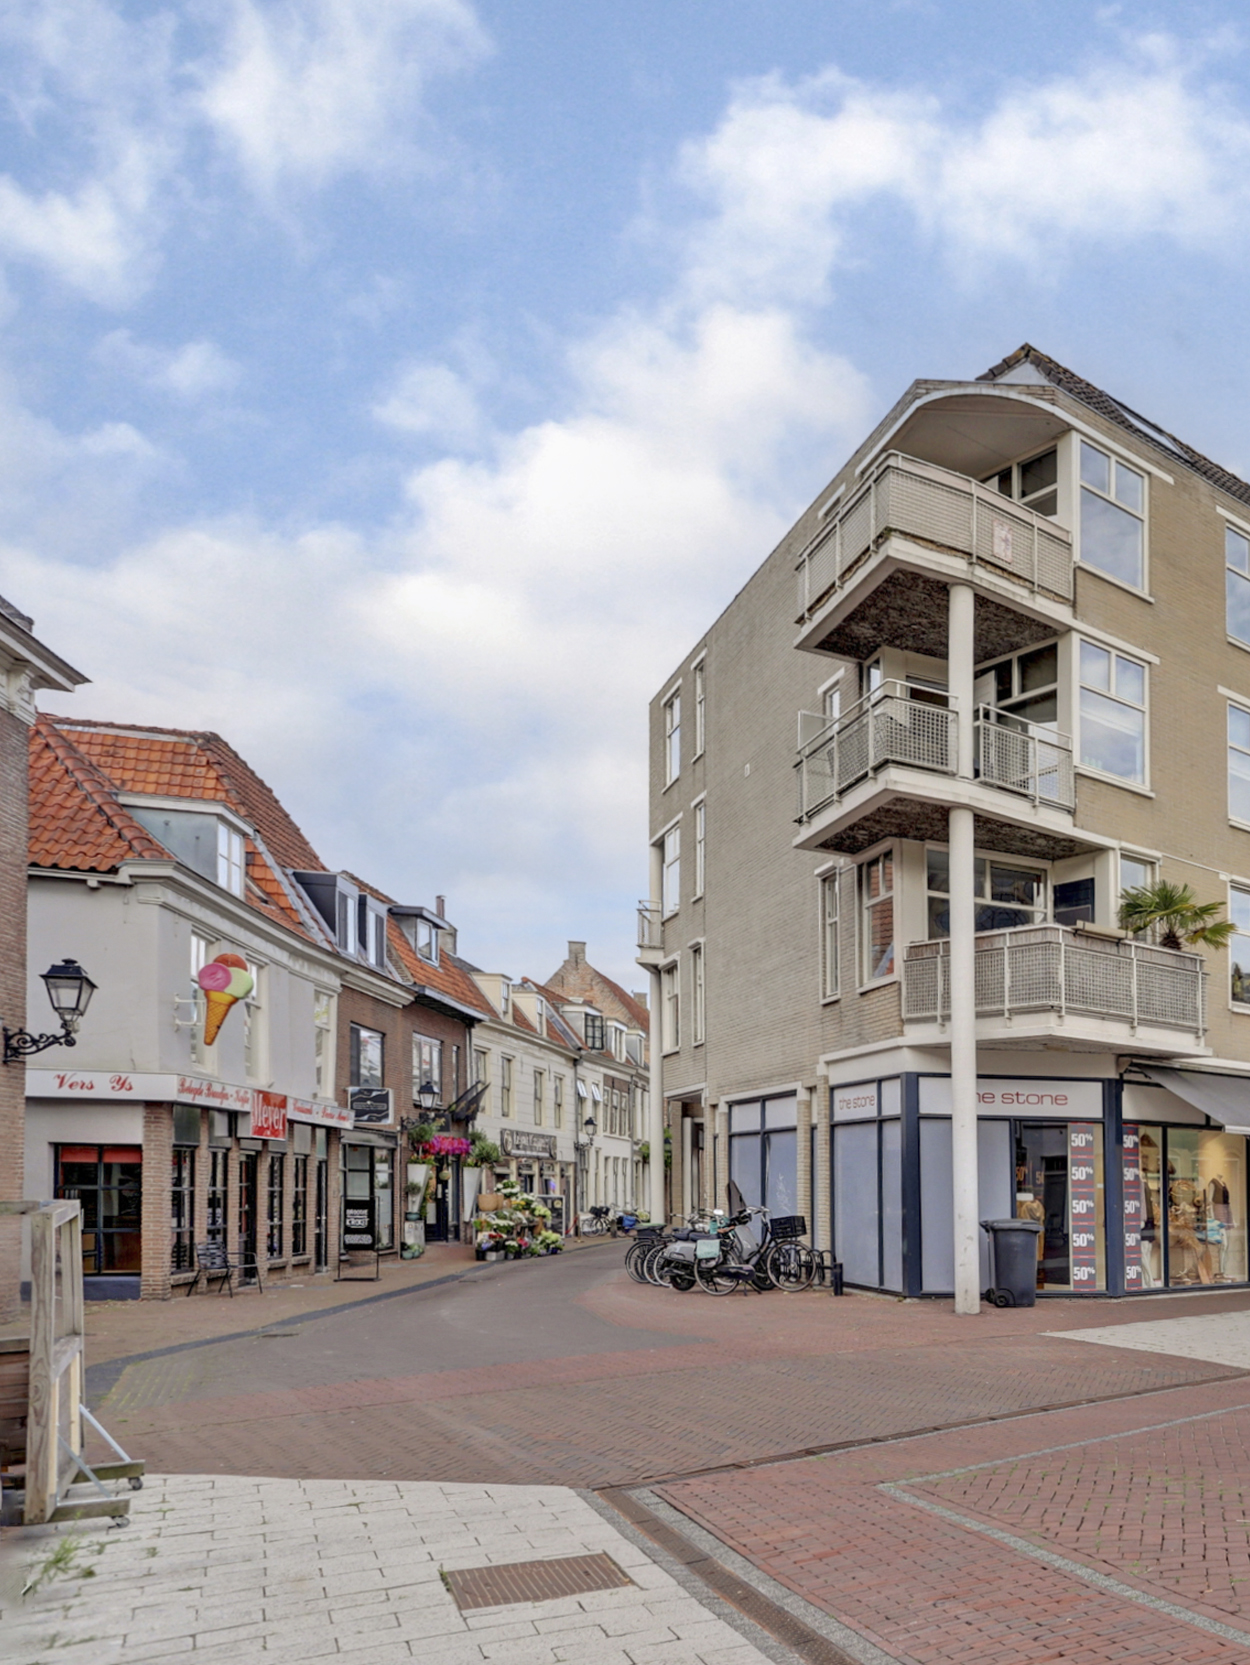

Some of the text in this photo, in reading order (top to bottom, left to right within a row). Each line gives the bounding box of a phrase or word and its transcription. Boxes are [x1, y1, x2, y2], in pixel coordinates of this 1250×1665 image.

[54, 1073, 95, 1090] Vers
[838, 1095, 876, 1110] the stone
[976, 1090, 1069, 1107] he stone
[1071, 1133, 1093, 1147] 50%
[1123, 1134, 1139, 1148] 50%
[1071, 1166, 1094, 1180] 50%
[1123, 1167, 1139, 1181] 50%
[1072, 1199, 1095, 1214] 50%
[1124, 1200, 1141, 1214] 50%
[1073, 1232, 1095, 1247] 50%
[1125, 1232, 1141, 1247] 50%
[1073, 1266, 1096, 1281] 50%
[1126, 1265, 1142, 1279] 50%
